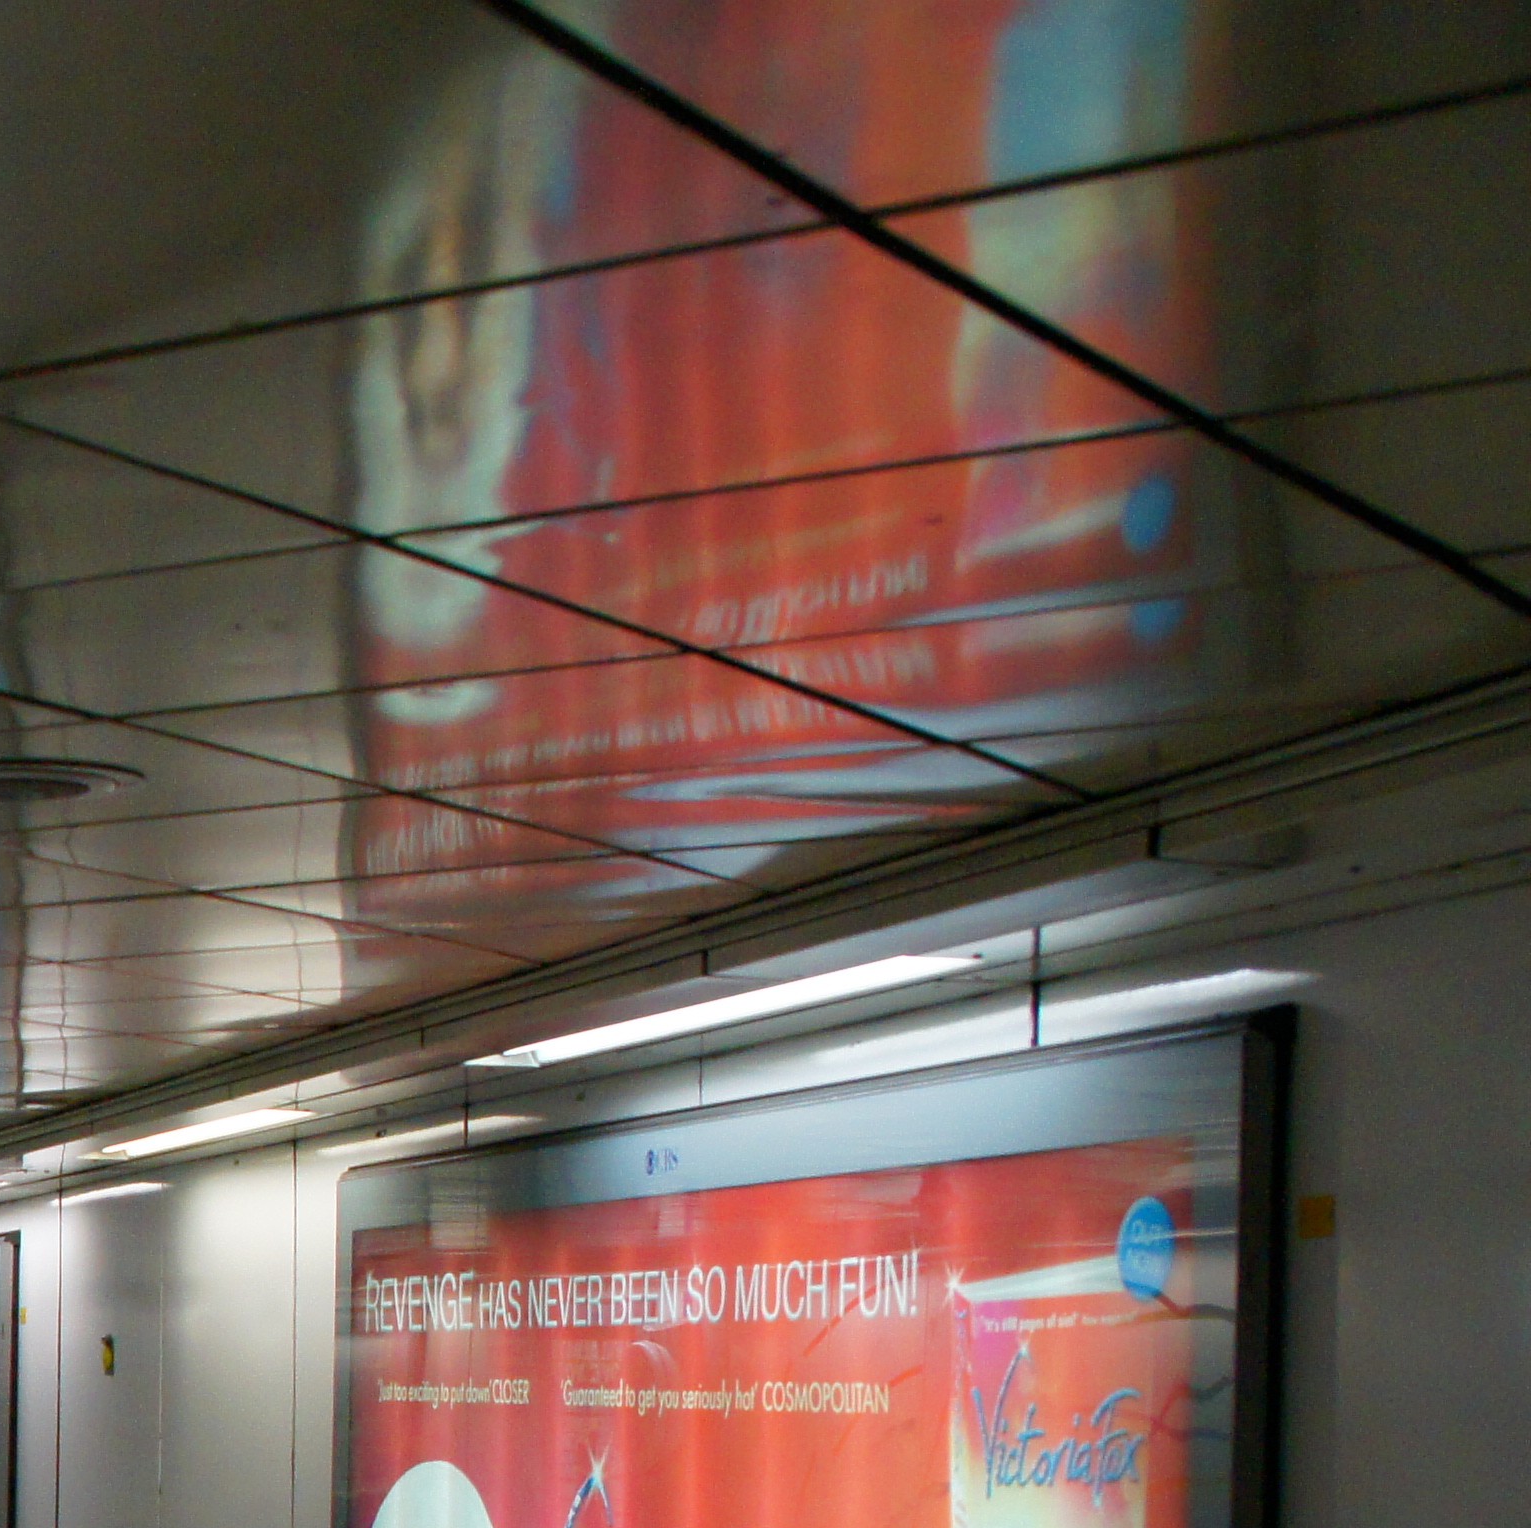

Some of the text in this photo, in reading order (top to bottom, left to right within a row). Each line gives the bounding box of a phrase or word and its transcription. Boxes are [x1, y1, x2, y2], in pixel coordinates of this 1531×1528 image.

[365, 1252, 920, 1333] REVENGE HAS NEVER BEEN SO MUCH FUN!
[408, 1380, 439, 1409] exciting
[440, 1382, 450, 1402] to
[450, 1382, 465, 1410] put
[492, 1379, 531, 1404] CLOSER
[624, 1383, 636, 1407] to
[638, 1385, 656, 1417] get
[657, 1389, 680, 1418] you
[681, 1379, 733, 1419] seriously
[762, 1380, 890, 1414] COSMOPOLITAN
[972, 1348, 1092, 1499] Victoria
[1091, 1388, 1144, 1507] Fox
